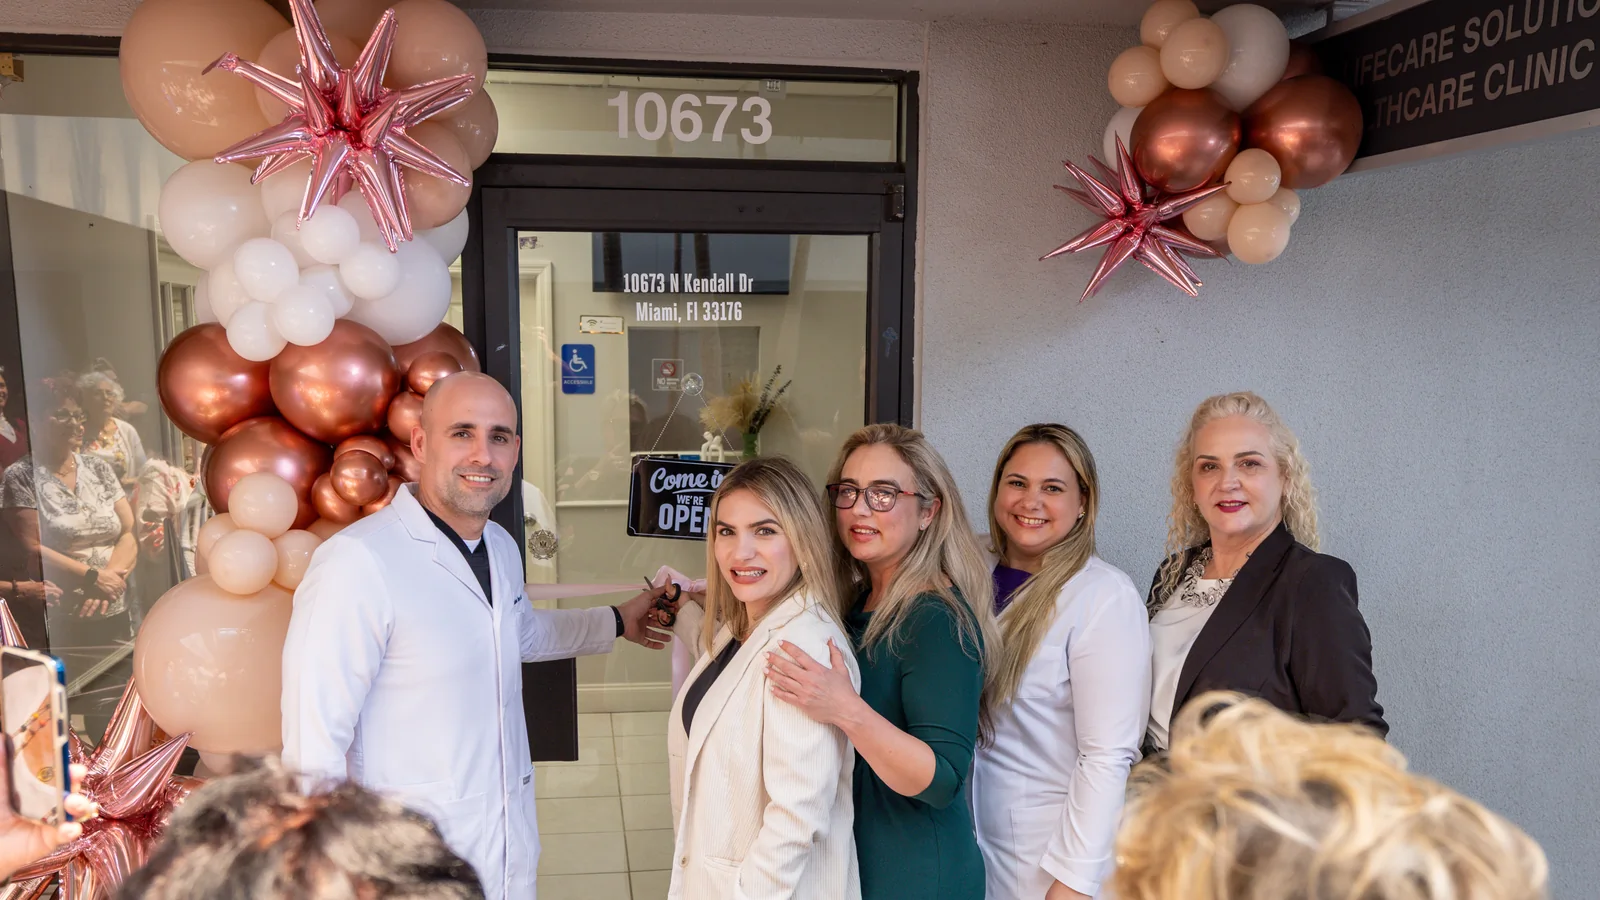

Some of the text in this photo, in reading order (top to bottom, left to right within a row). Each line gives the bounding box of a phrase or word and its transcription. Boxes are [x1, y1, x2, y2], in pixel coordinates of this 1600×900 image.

[1344, 25, 1456, 87] IFECARE
[1369, 38, 1595, 130] THCARE CLINIC
[608, 91, 773, 144] 10673
[623, 273, 754, 293] 10673 N Kendall Dr
[636, 302, 682, 323] Miami,
[702, 301, 742, 321] 33176
[649, 467, 709, 493] Come
[676, 494, 704, 506] WE'RE
